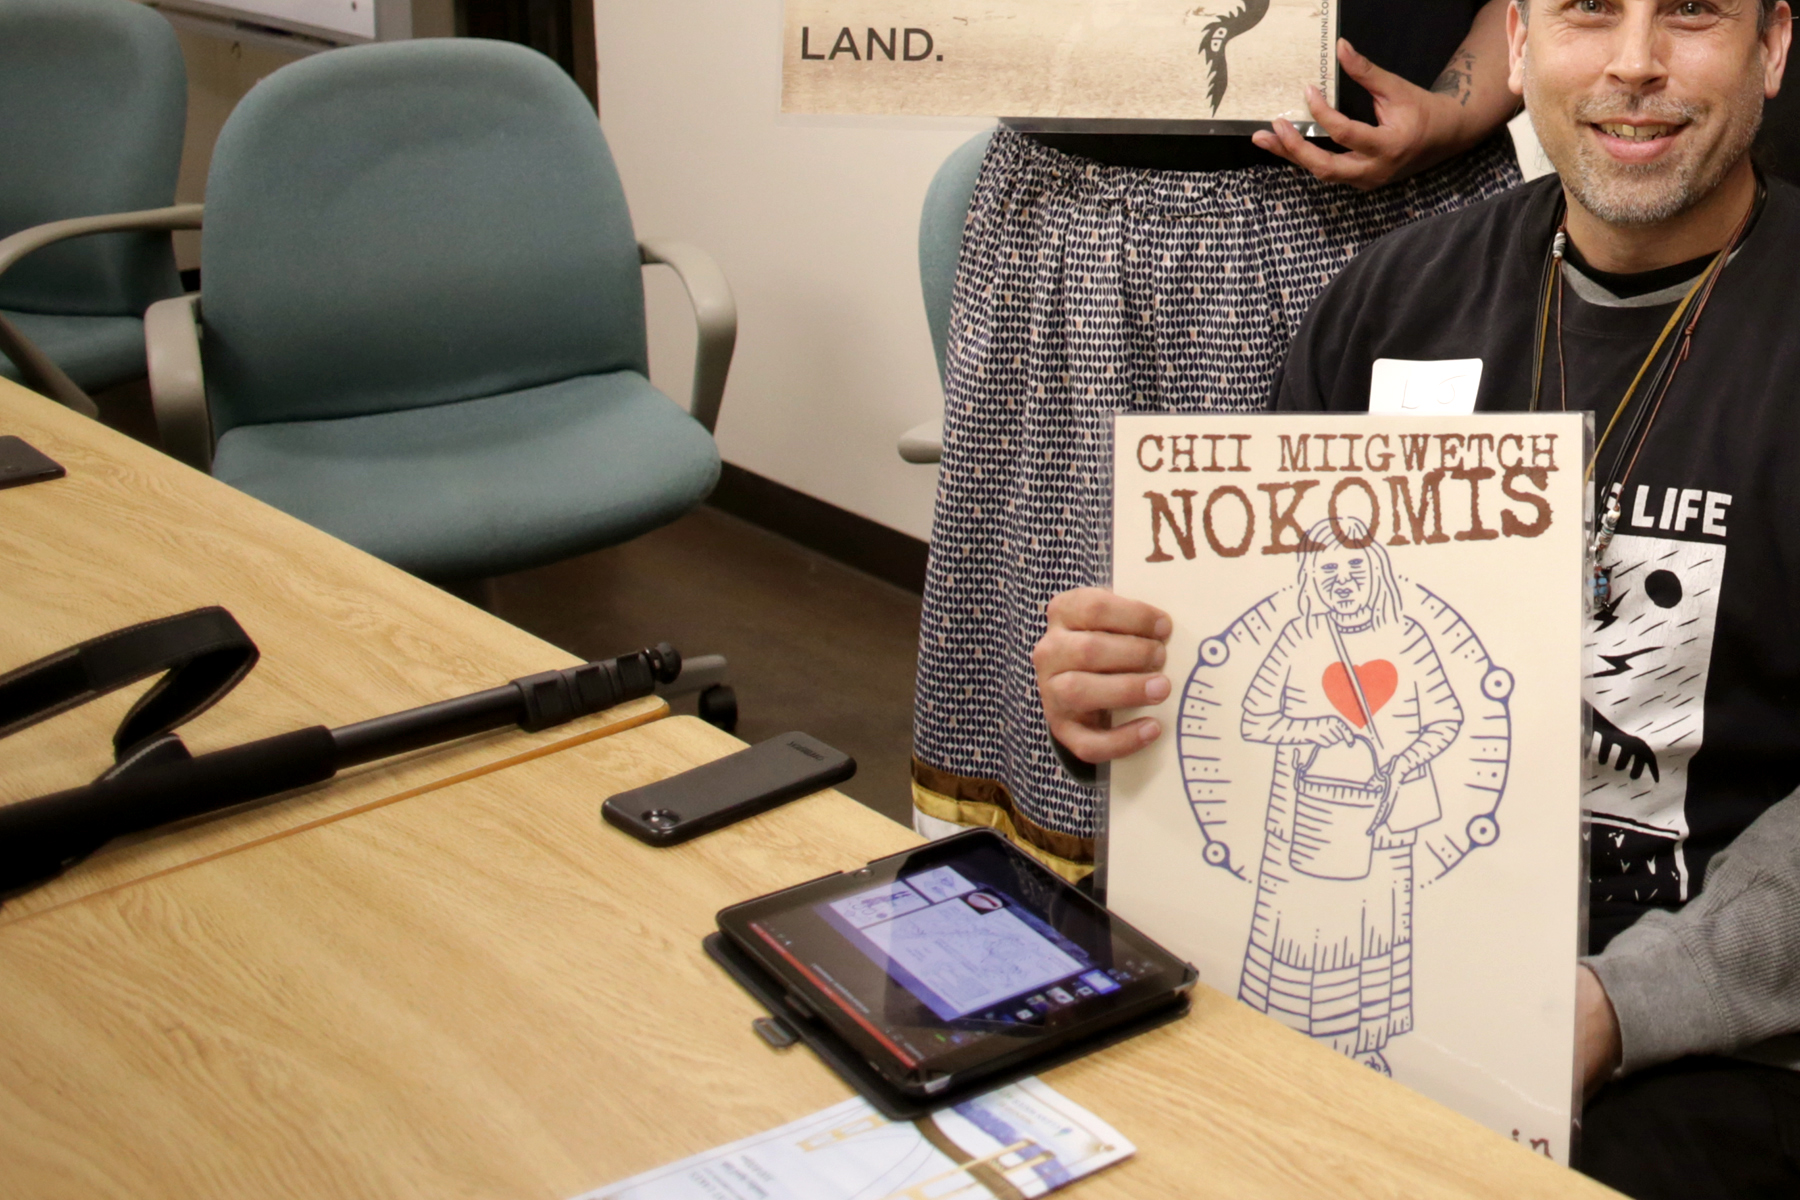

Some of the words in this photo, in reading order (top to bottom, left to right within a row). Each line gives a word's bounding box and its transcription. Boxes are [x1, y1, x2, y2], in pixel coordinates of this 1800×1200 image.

[801, 26, 944, 62] LAND.
[1136, 433, 1252, 472] CHII
[1277, 433, 1560, 472] MIIGWETCH
[1142, 467, 1555, 563] NOKOMIS
[1631, 484, 1733, 537] LIFE
